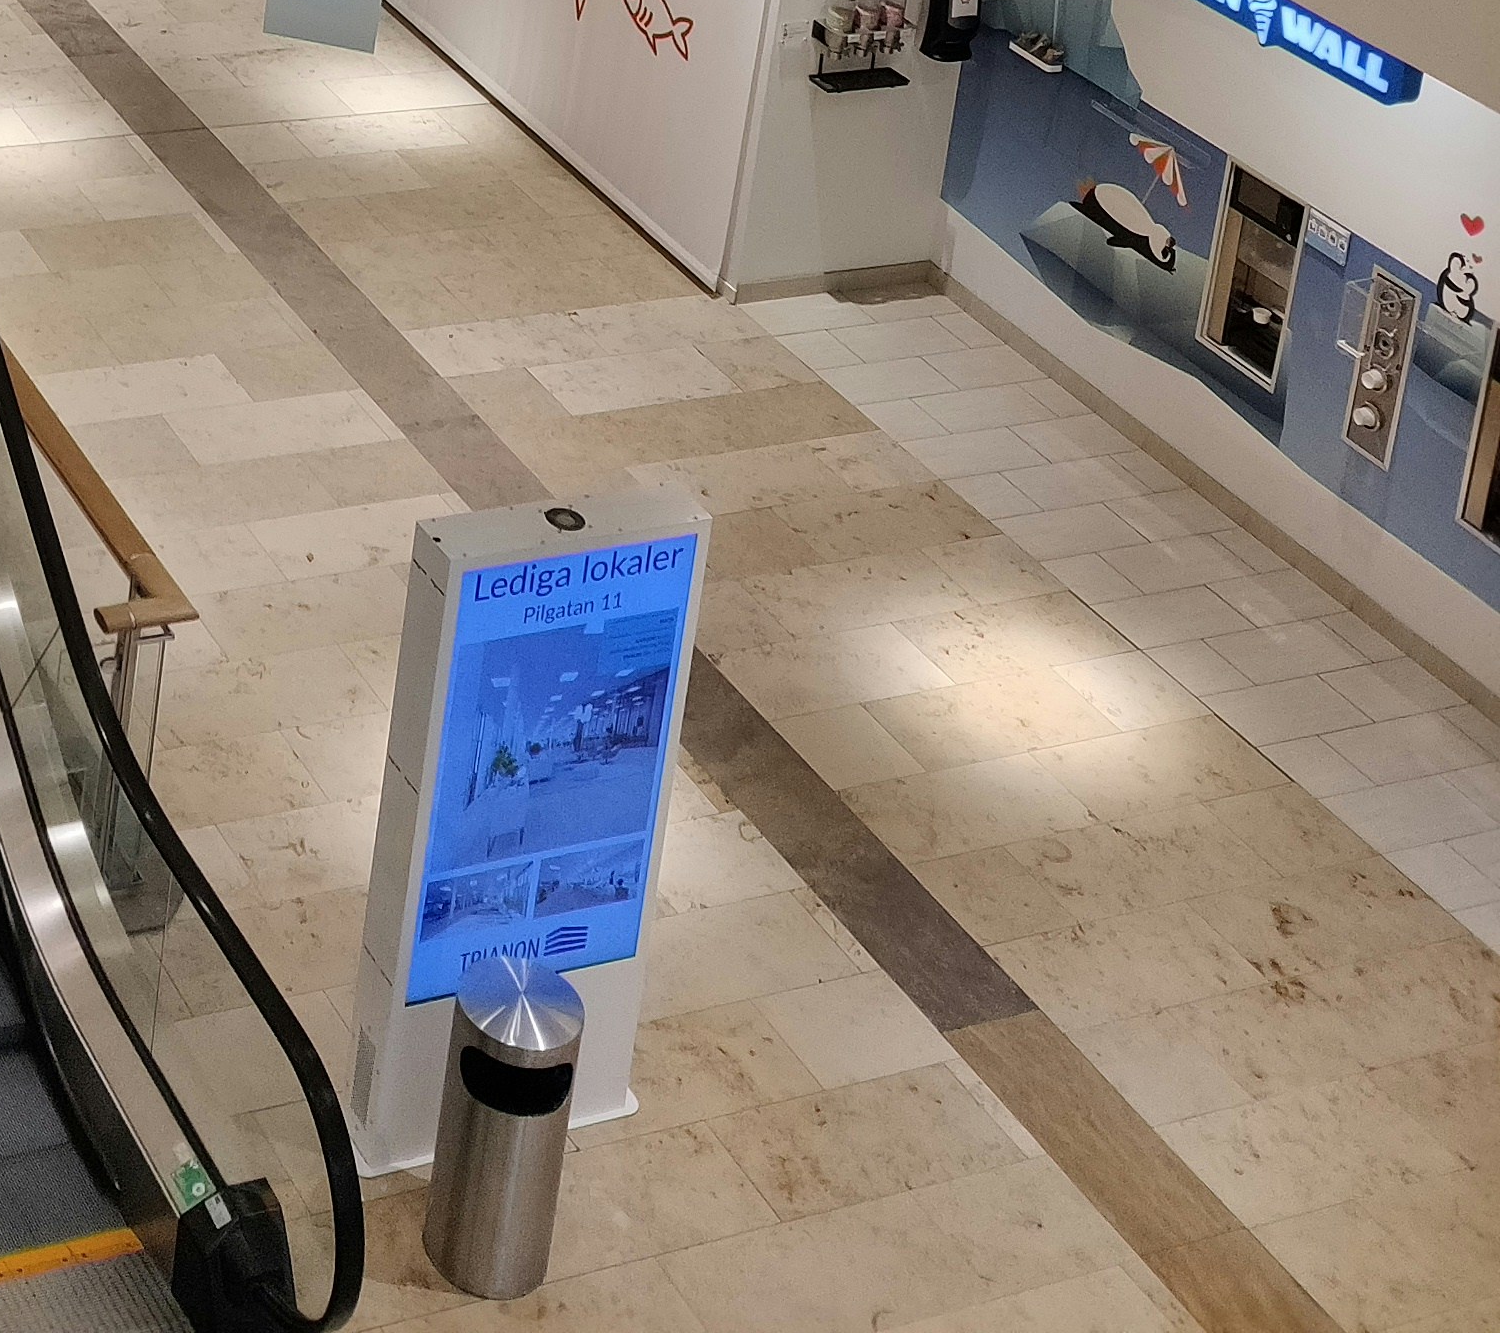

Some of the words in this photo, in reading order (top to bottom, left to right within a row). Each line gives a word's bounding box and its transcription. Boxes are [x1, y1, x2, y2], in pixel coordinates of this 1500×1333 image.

[1281, 6, 1389, 94] WALL
[474, 563, 571, 602] Lediga
[582, 545, 684, 585] lokaler
[523, 599, 595, 625] Pilgatan
[601, 592, 623, 612] 11
